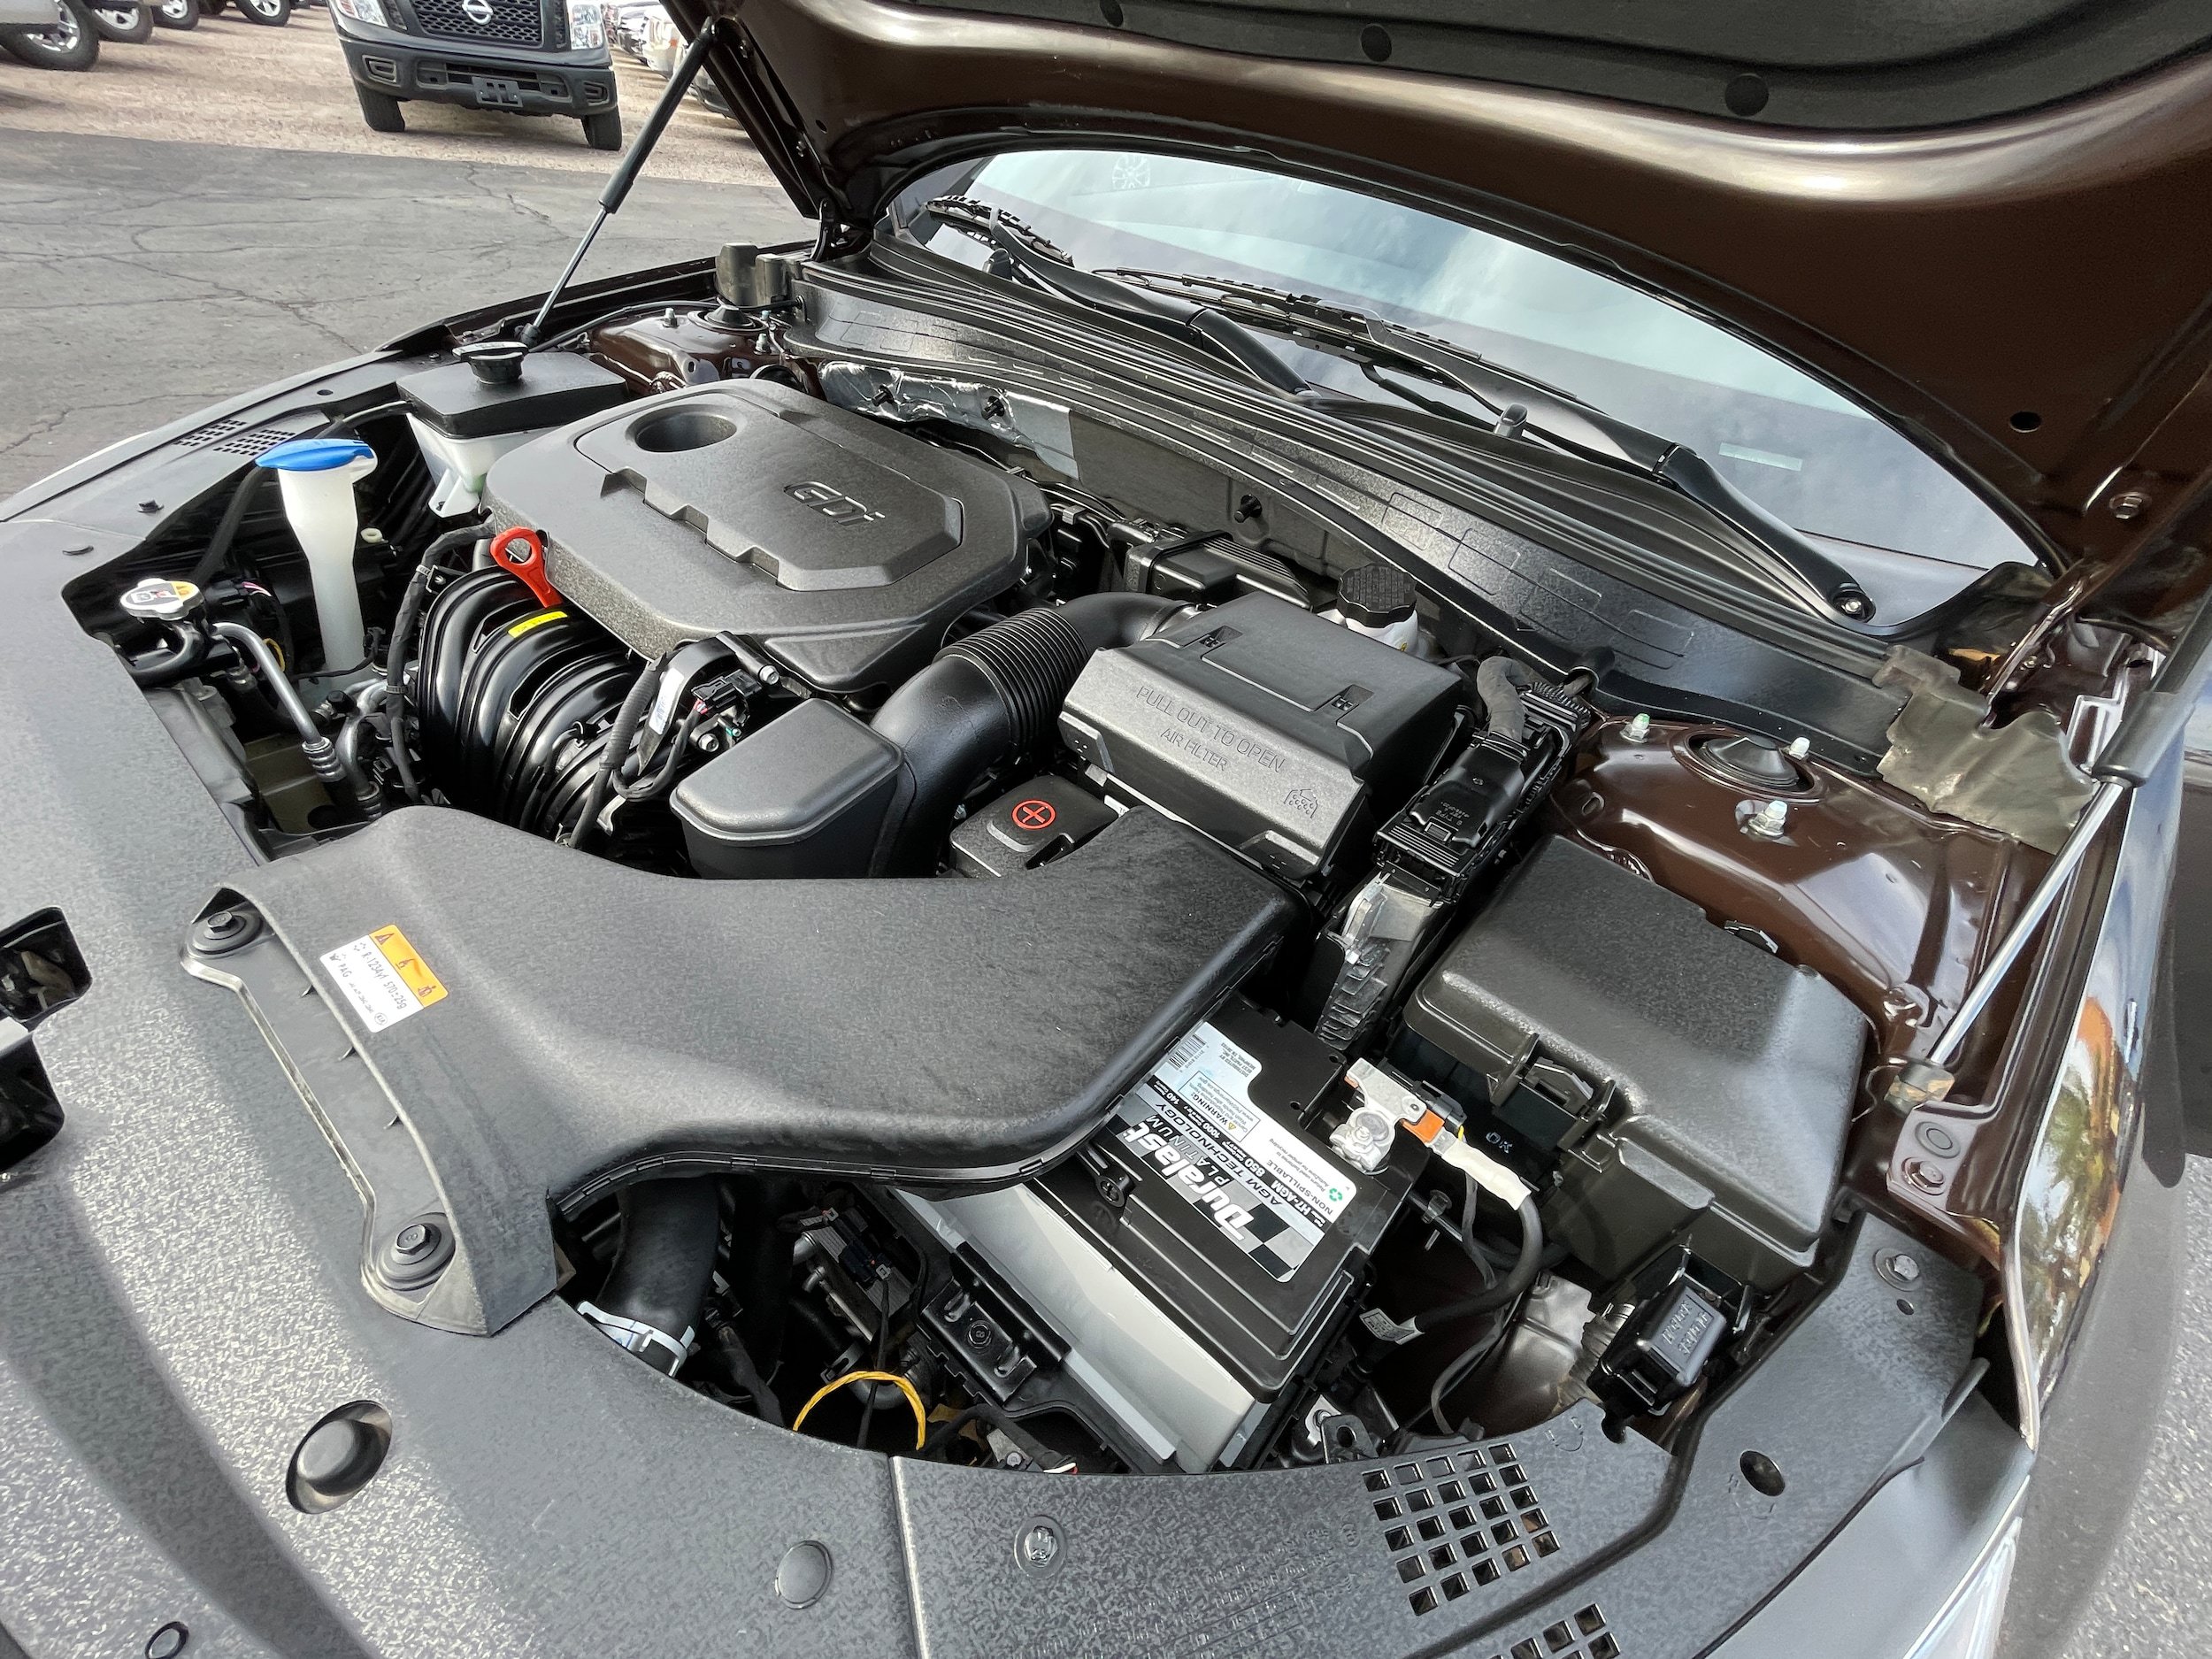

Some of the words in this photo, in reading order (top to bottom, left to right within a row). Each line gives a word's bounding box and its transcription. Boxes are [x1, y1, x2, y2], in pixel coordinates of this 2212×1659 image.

[783, 480, 885, 526] GDi
[1135, 685, 1177, 716] PULL
[1175, 706, 1214, 733] OUT
[1211, 724, 1236, 747] TO
[1234, 737, 1286, 772] OPEN
[1160, 726, 1184, 747] AIR
[1184, 739, 1228, 772] FILTER
[337, 962, 353, 979] PAG
[1165, 1091, 1180, 1105] 140
[1189, 1091, 1228, 1125] WARNING:
[1145, 1113, 1230, 1186] PLATINUM
[1154, 1104, 1245, 1177] TECHNOLOGY
[1201, 1121, 1221, 1140] 1000
[1122, 1120, 1255, 1242] Duralast
[1242, 1156, 1266, 1177] 850
[1245, 1178, 1282, 1204] AGM
[1265, 1159, 1333, 1216] NON-SPILLABLE
[1270, 1179, 1312, 1215] H7-AGM
